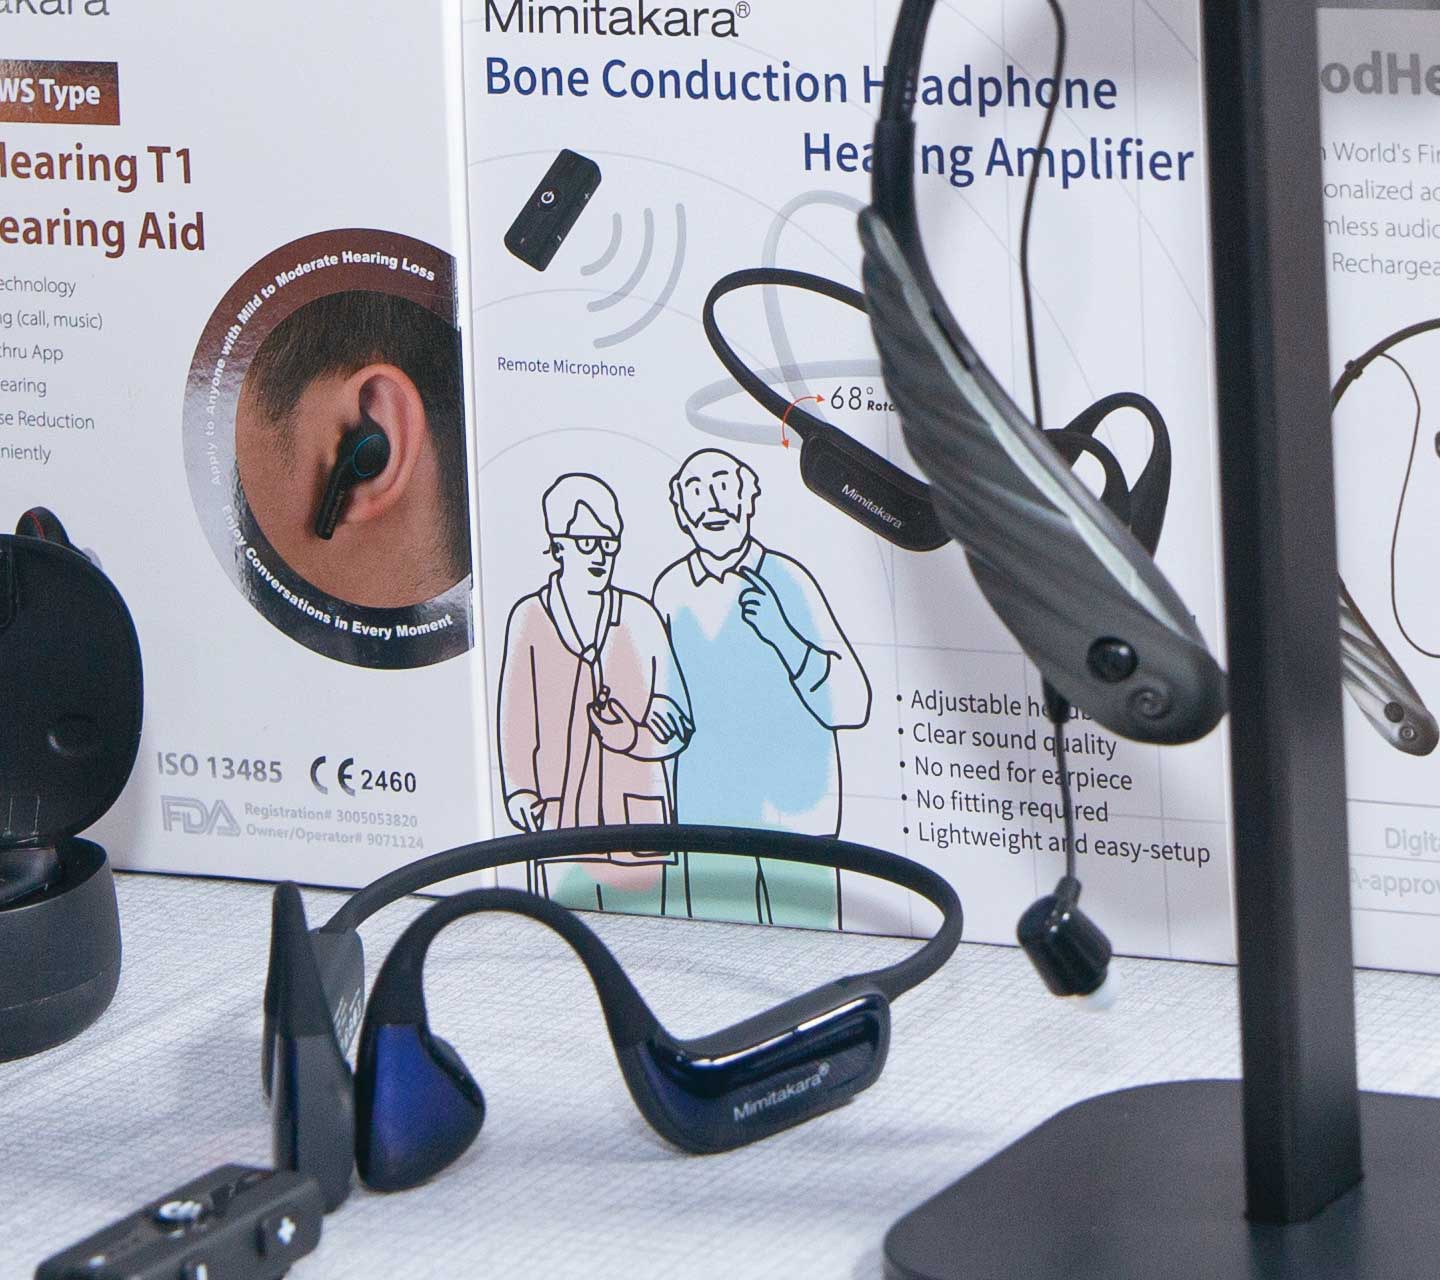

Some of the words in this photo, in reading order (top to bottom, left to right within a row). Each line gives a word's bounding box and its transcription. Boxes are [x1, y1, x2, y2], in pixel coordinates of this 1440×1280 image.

[39, 78, 101, 111] Type
[485, 57, 590, 97] Bone
[601, 58, 848, 104] Conduction
[863, 64, 1118, 118] Hadphone
[147, 146, 193, 184] T1
[804, 132, 974, 188] Heng
[985, 136, 1195, 188] Amplifier
[1333, 142, 1411, 166] World's
[1323, 179, 1413, 201] onalized
[139, 212, 206, 251] Aid
[275, 253, 338, 289] Moderate
[341, 250, 399, 270] Hearing
[401, 257, 435, 282] Loss
[260, 282, 277, 299] to
[17, 309, 50, 329] (call,
[54, 313, 103, 330] music)
[236, 295, 263, 326] Mild
[32, 344, 64, 362] App
[220, 324, 243, 358] with
[497, 357, 550, 374] Remote
[553, 359, 635, 380] Microphone
[205, 356, 227, 416] Anyone
[18, 411, 95, 430] Reduction
[205, 419, 217, 440] to
[841, 484, 903, 529] Mimitakara
[221, 504, 248, 547] Enjoy
[245, 547, 331, 625] Conversations
[334, 615, 347, 630] in
[352, 620, 393, 640] Every
[396, 613, 454, 638] Moment
[911, 689, 1021, 718] Adjustable
[913, 723, 966, 746] Clear
[972, 728, 1036, 752] sound
[157, 751, 198, 777] ISO
[207, 756, 283, 783] 13485
[361, 769, 416, 793] 2460
[915, 756, 943, 777] No
[950, 757, 1000, 782] need
[1007, 761, 1037, 784] for
[160, 795, 241, 838] FDA
[245, 802, 332, 821] Registration#
[917, 789, 945, 810] No
[951, 790, 1013, 821] fitting
[1019, 800, 1109, 824] requred
[246, 824, 362, 845] Owner/Operator#
[919, 822, 1043, 855] Lightweight
[1095, 840, 1211, 867] easy-setup
